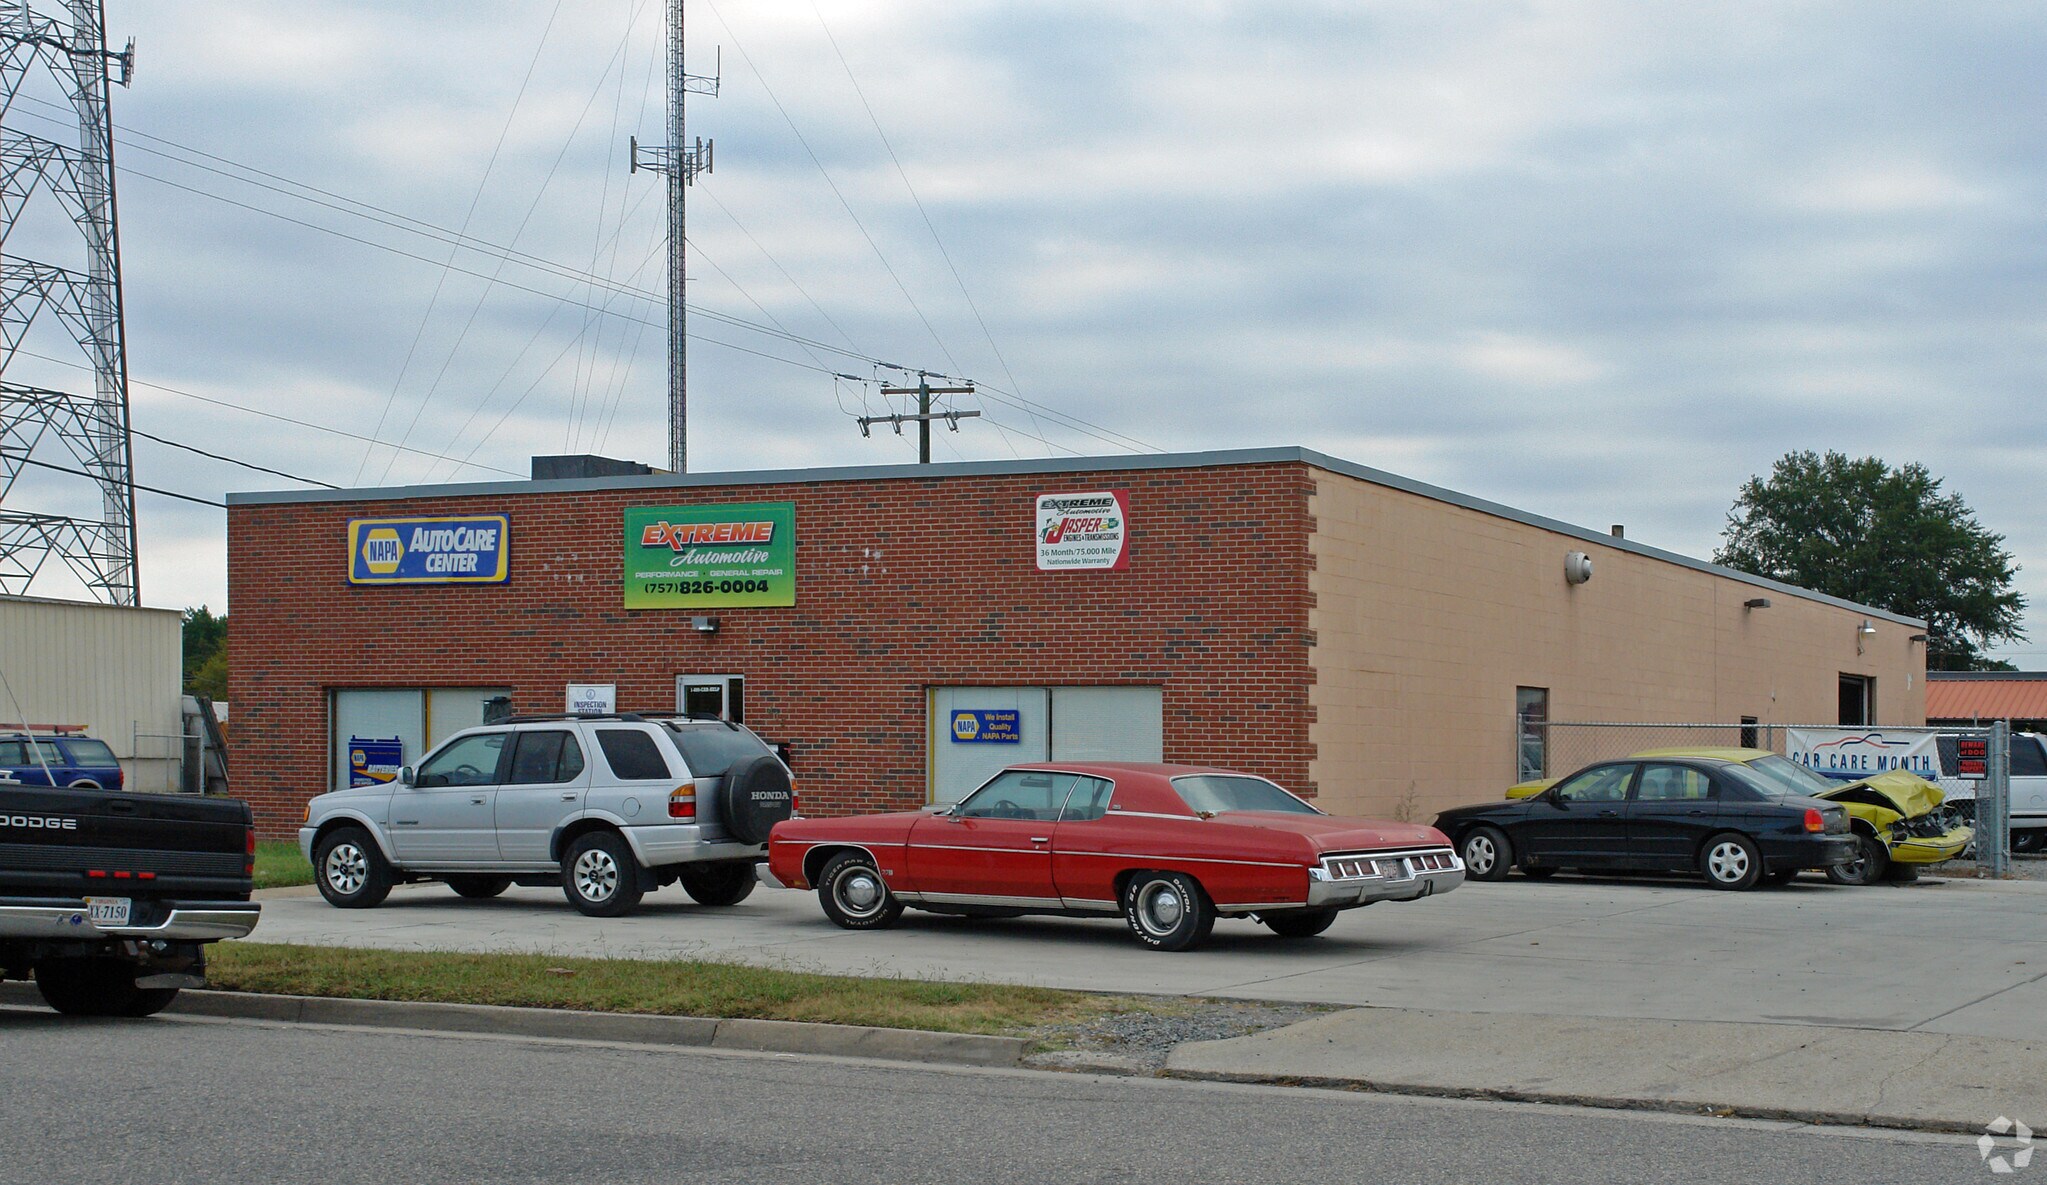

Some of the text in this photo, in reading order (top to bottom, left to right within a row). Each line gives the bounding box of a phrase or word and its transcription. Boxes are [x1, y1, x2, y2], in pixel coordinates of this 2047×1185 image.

[1040, 497, 1114, 510] EXTREME
[1056, 508, 1111, 516] Automotive
[641, 520, 775, 552] EXTREME
[1045, 517, 1102, 544] JASPER
[1063, 533, 1081, 542] ENGINES
[1085, 532, 1119, 541] TRANSMISSIONS
[369, 541, 398, 561] NAPA
[670, 547, 769, 567] Automotive
[1040, 549, 1049, 557] 36
[1101, 547, 1116, 555] Mile
[425, 553, 478, 573] CENTER
[1047, 557, 1110, 566] Nationwide Warranty
[635, 568, 783, 579] PERFORMANCE GENERAL REPAIR
[996, 713, 1015, 721] Install
[957, 721, 975, 733] NAPA
[989, 723, 1011, 731] Quality
[1793, 752, 1930, 771] CAR CARE MONTH
[751, 791, 789, 800] HONDA
[825, 863, 842, 886] TIGER
[1173, 878, 1191, 913] DAYTON
[1128, 907, 1161, 945] DAYTONA
